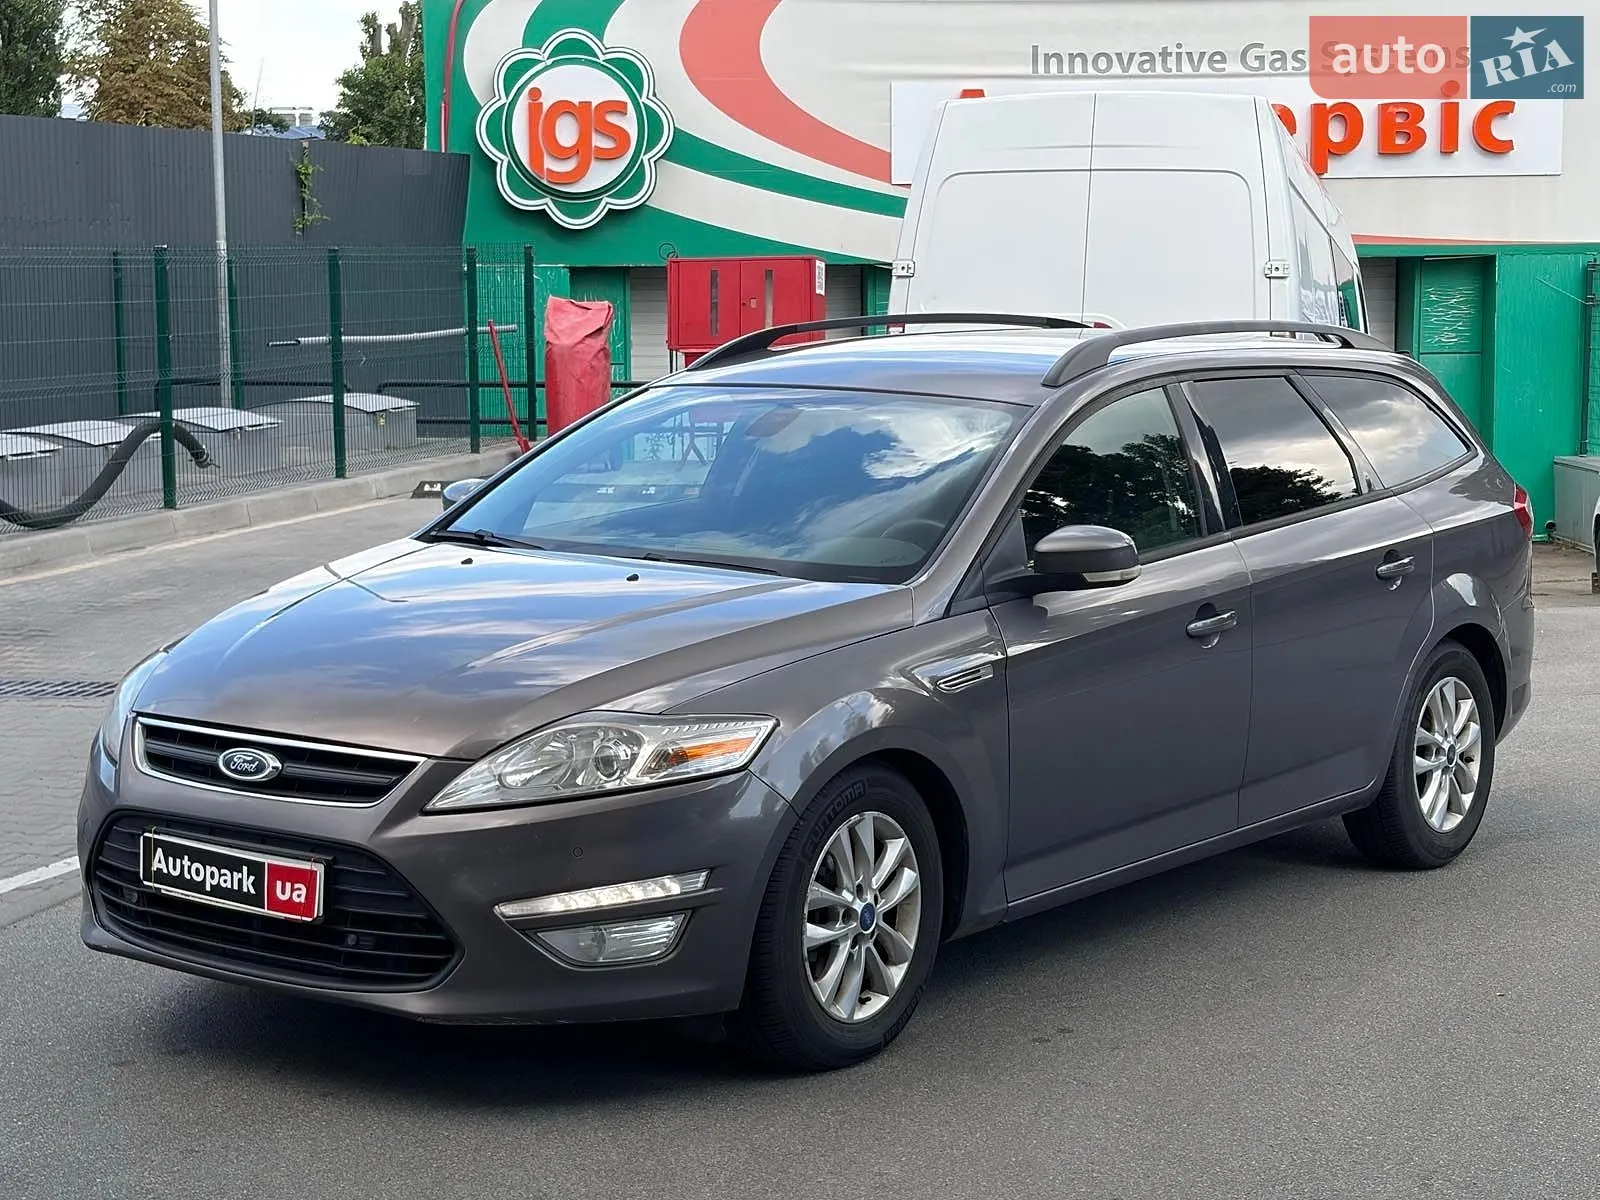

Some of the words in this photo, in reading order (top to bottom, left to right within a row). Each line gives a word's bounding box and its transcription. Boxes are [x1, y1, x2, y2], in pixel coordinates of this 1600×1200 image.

[1031, 43, 1228, 75] Innovative
[1239, 42, 1307, 73] Gas
[527, 86, 632, 184] igs
[229, 755, 260, 773] Ford
[152, 847, 257, 895] Autopark
[275, 879, 307, 904] ua
